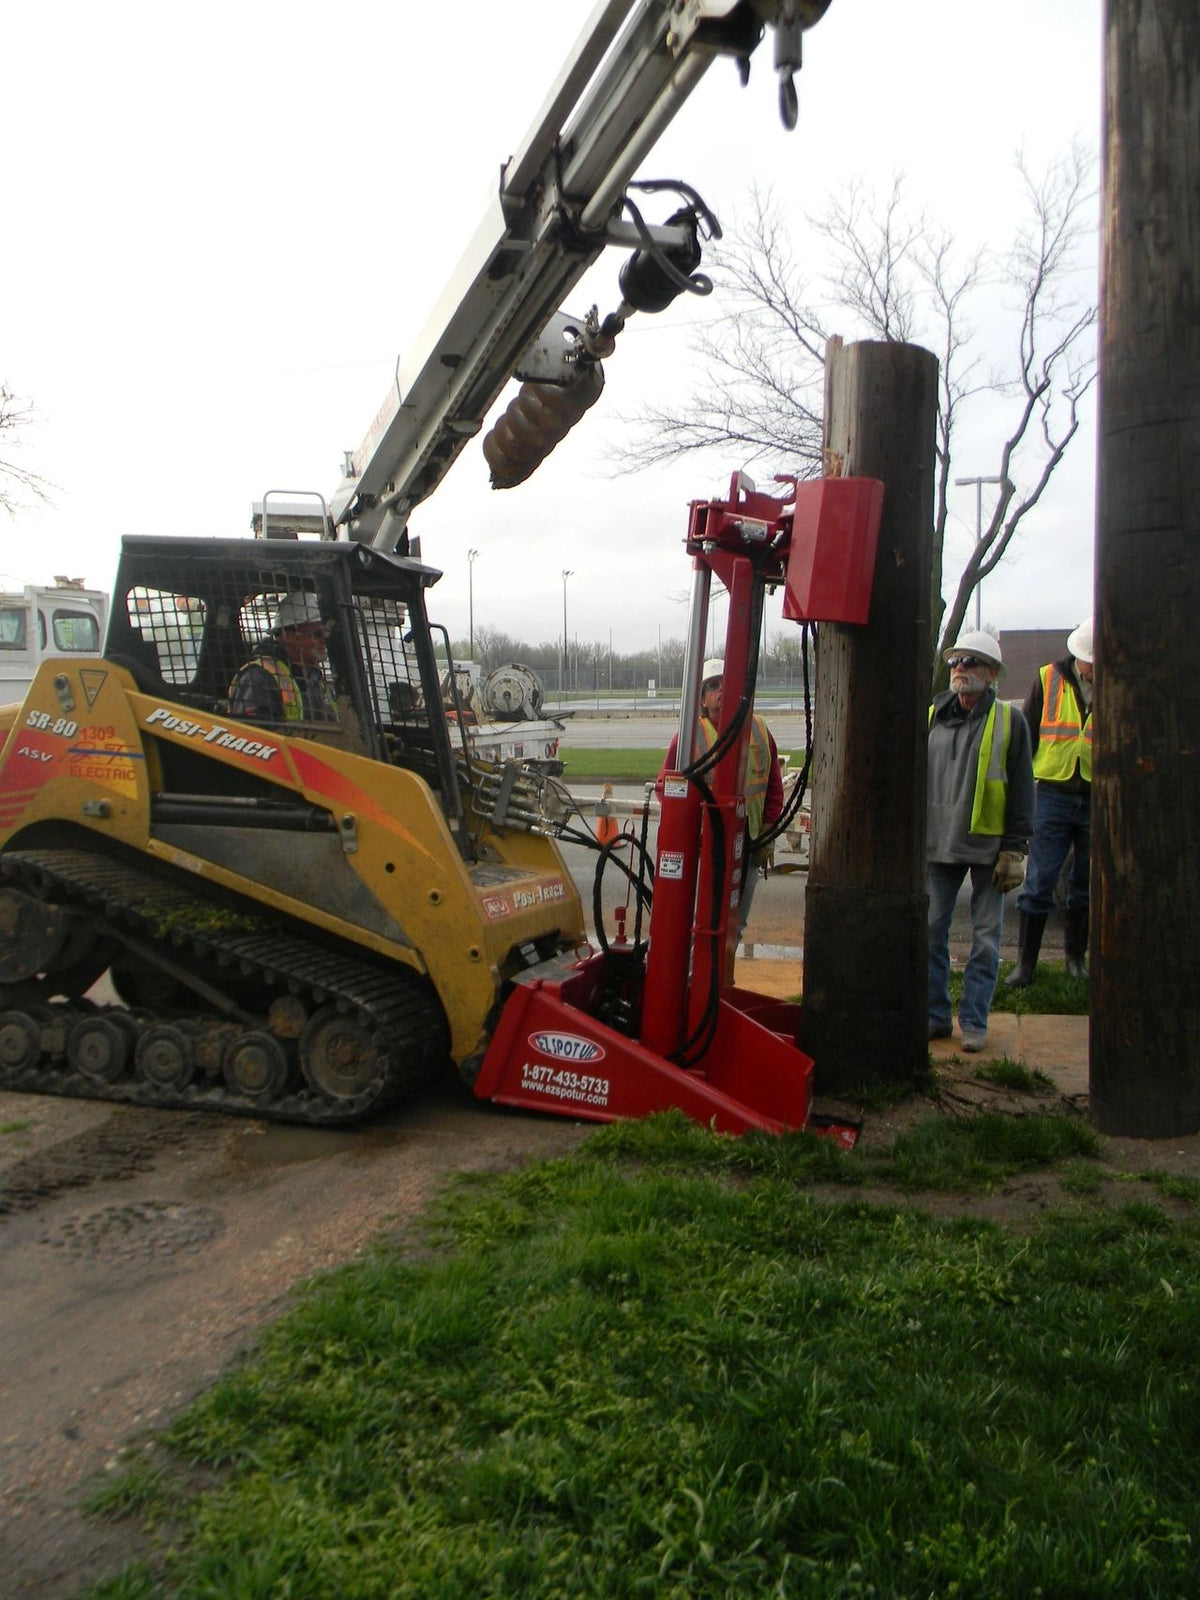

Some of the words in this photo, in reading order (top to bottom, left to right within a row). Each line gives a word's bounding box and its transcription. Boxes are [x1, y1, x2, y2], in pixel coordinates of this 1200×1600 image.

[26, 710, 78, 738] SR-80
[80, 725, 116, 741] 1309
[18, 746, 53, 762] ASV
[69, 765, 136, 781] ELECTRIC
[522, 1062, 609, 1095] 1-877-433-5733
[521, 1078, 608, 1106] www.ezspotur.com
